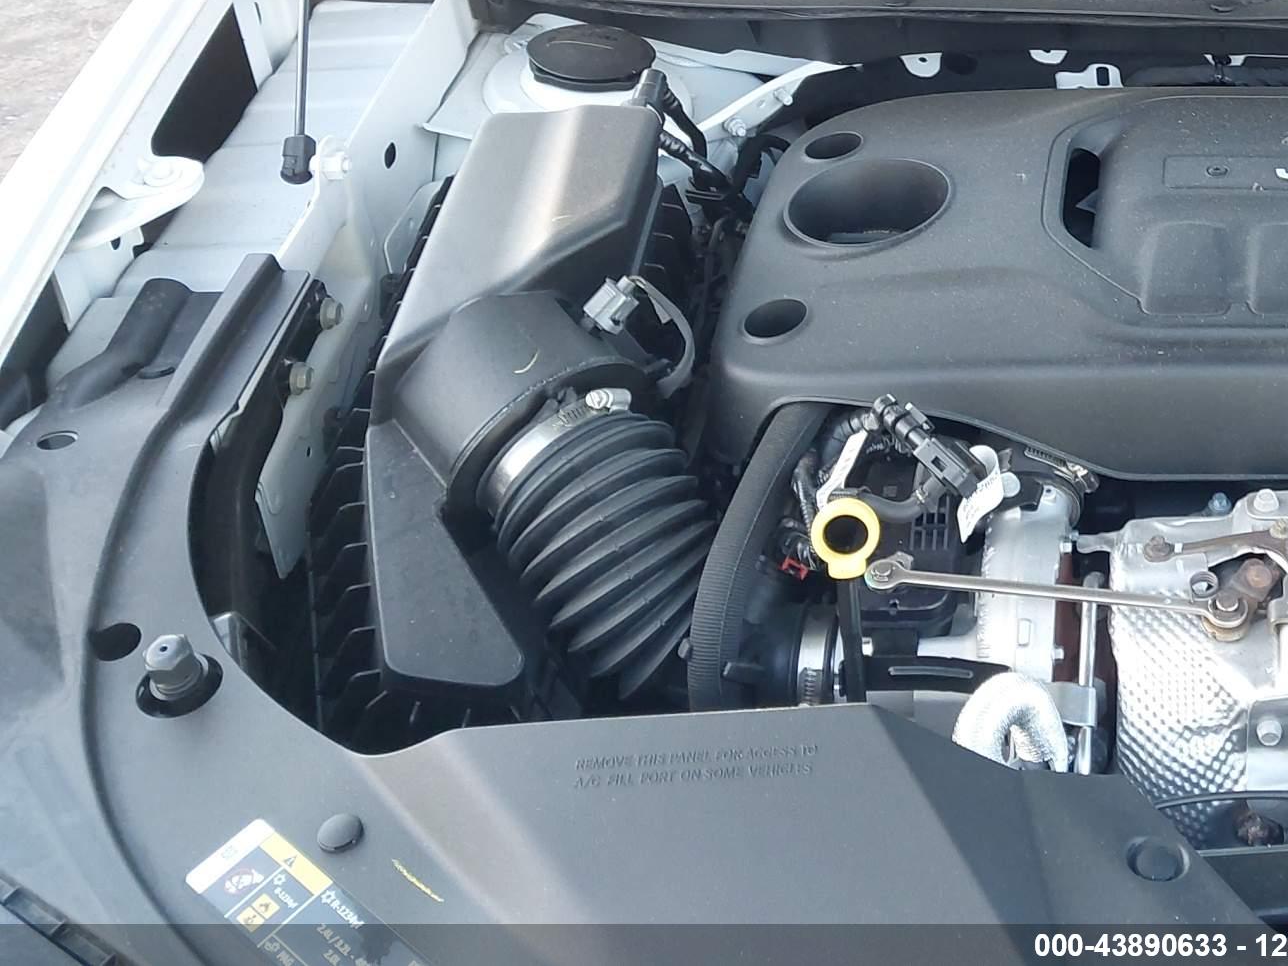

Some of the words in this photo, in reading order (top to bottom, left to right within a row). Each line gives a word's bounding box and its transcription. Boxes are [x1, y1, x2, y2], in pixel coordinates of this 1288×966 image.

[575, 755, 632, 771] REMOVE
[637, 753, 665, 767] THIS
[669, 749, 711, 765] PANEL
[715, 748, 743, 762] FOR
[747, 745, 797, 760] ACCESS
[800, 743, 819, 756] TO
[607, 773, 634, 787] FILL
[639, 770, 676, 785] PORT
[680, 768, 701, 782] ON
[701, 765, 742, 780] SOME
[747, 762, 814, 777] VEHICLES
